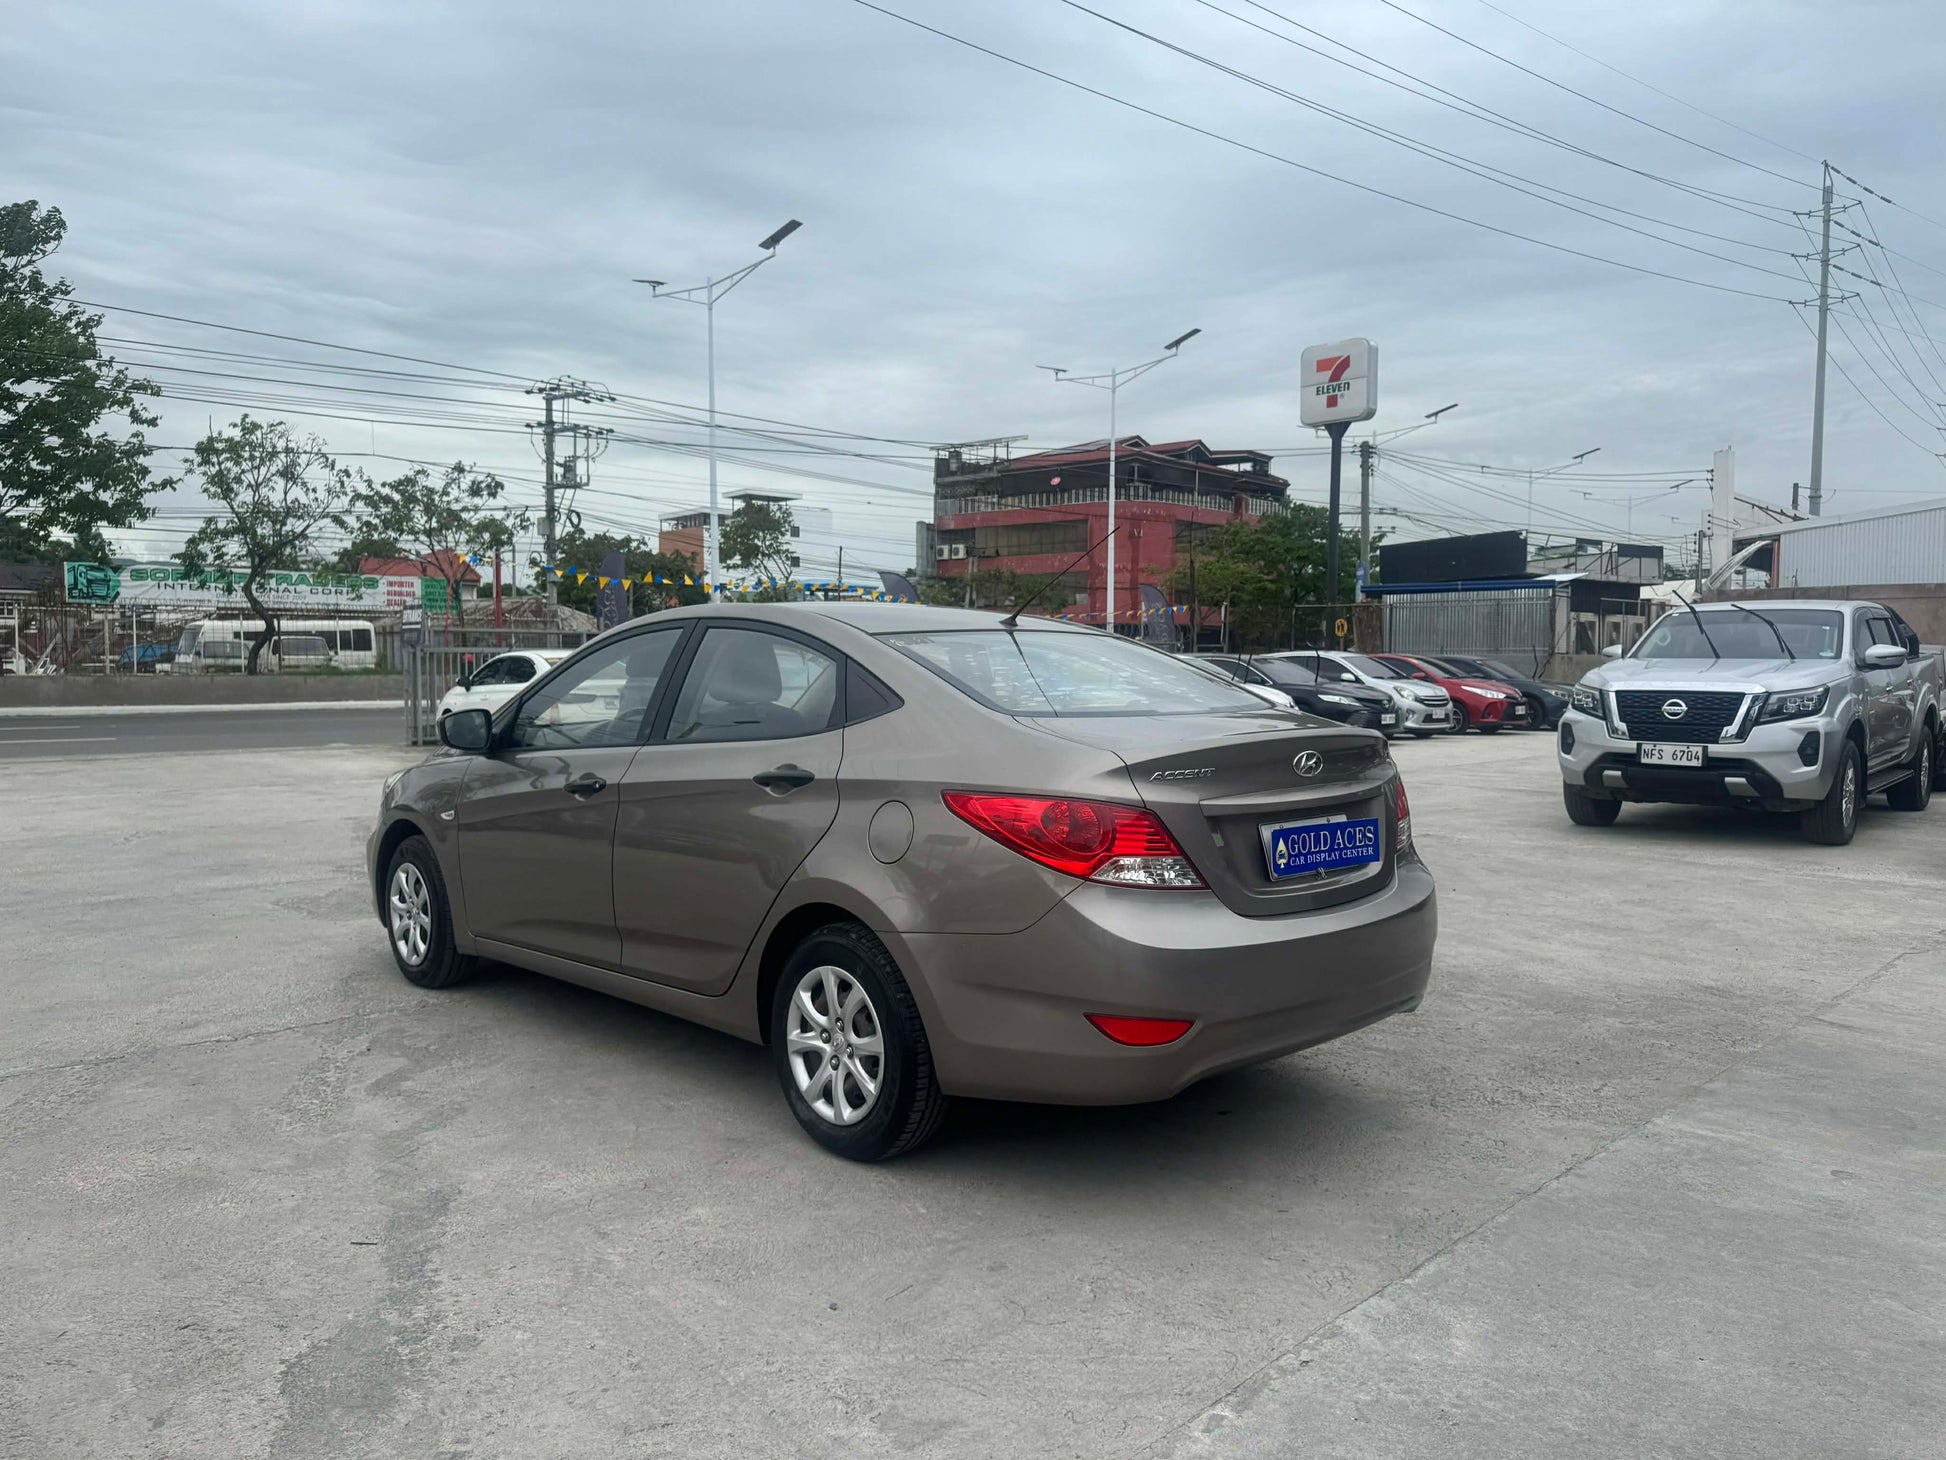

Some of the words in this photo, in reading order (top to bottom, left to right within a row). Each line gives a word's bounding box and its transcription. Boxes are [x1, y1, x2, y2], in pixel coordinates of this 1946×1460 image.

[1316, 354, 1351, 408] 7
[1316, 381, 1350, 396] ELEVEn
[157, 582, 302, 594] INTERNTONAL
[386, 580, 415, 589] IMPORTER
[1643, 748, 1664, 760] NFS
[1672, 750, 1700, 762] 6704
[1149, 767, 1216, 782] ACCENT
[1288, 830, 1331, 855] GOLD
[1335, 825, 1375, 848] ACES
[1290, 856, 1306, 866] CAR
[1307, 851, 1340, 864] DISPLAY
[1342, 847, 1374, 859] CENTER
